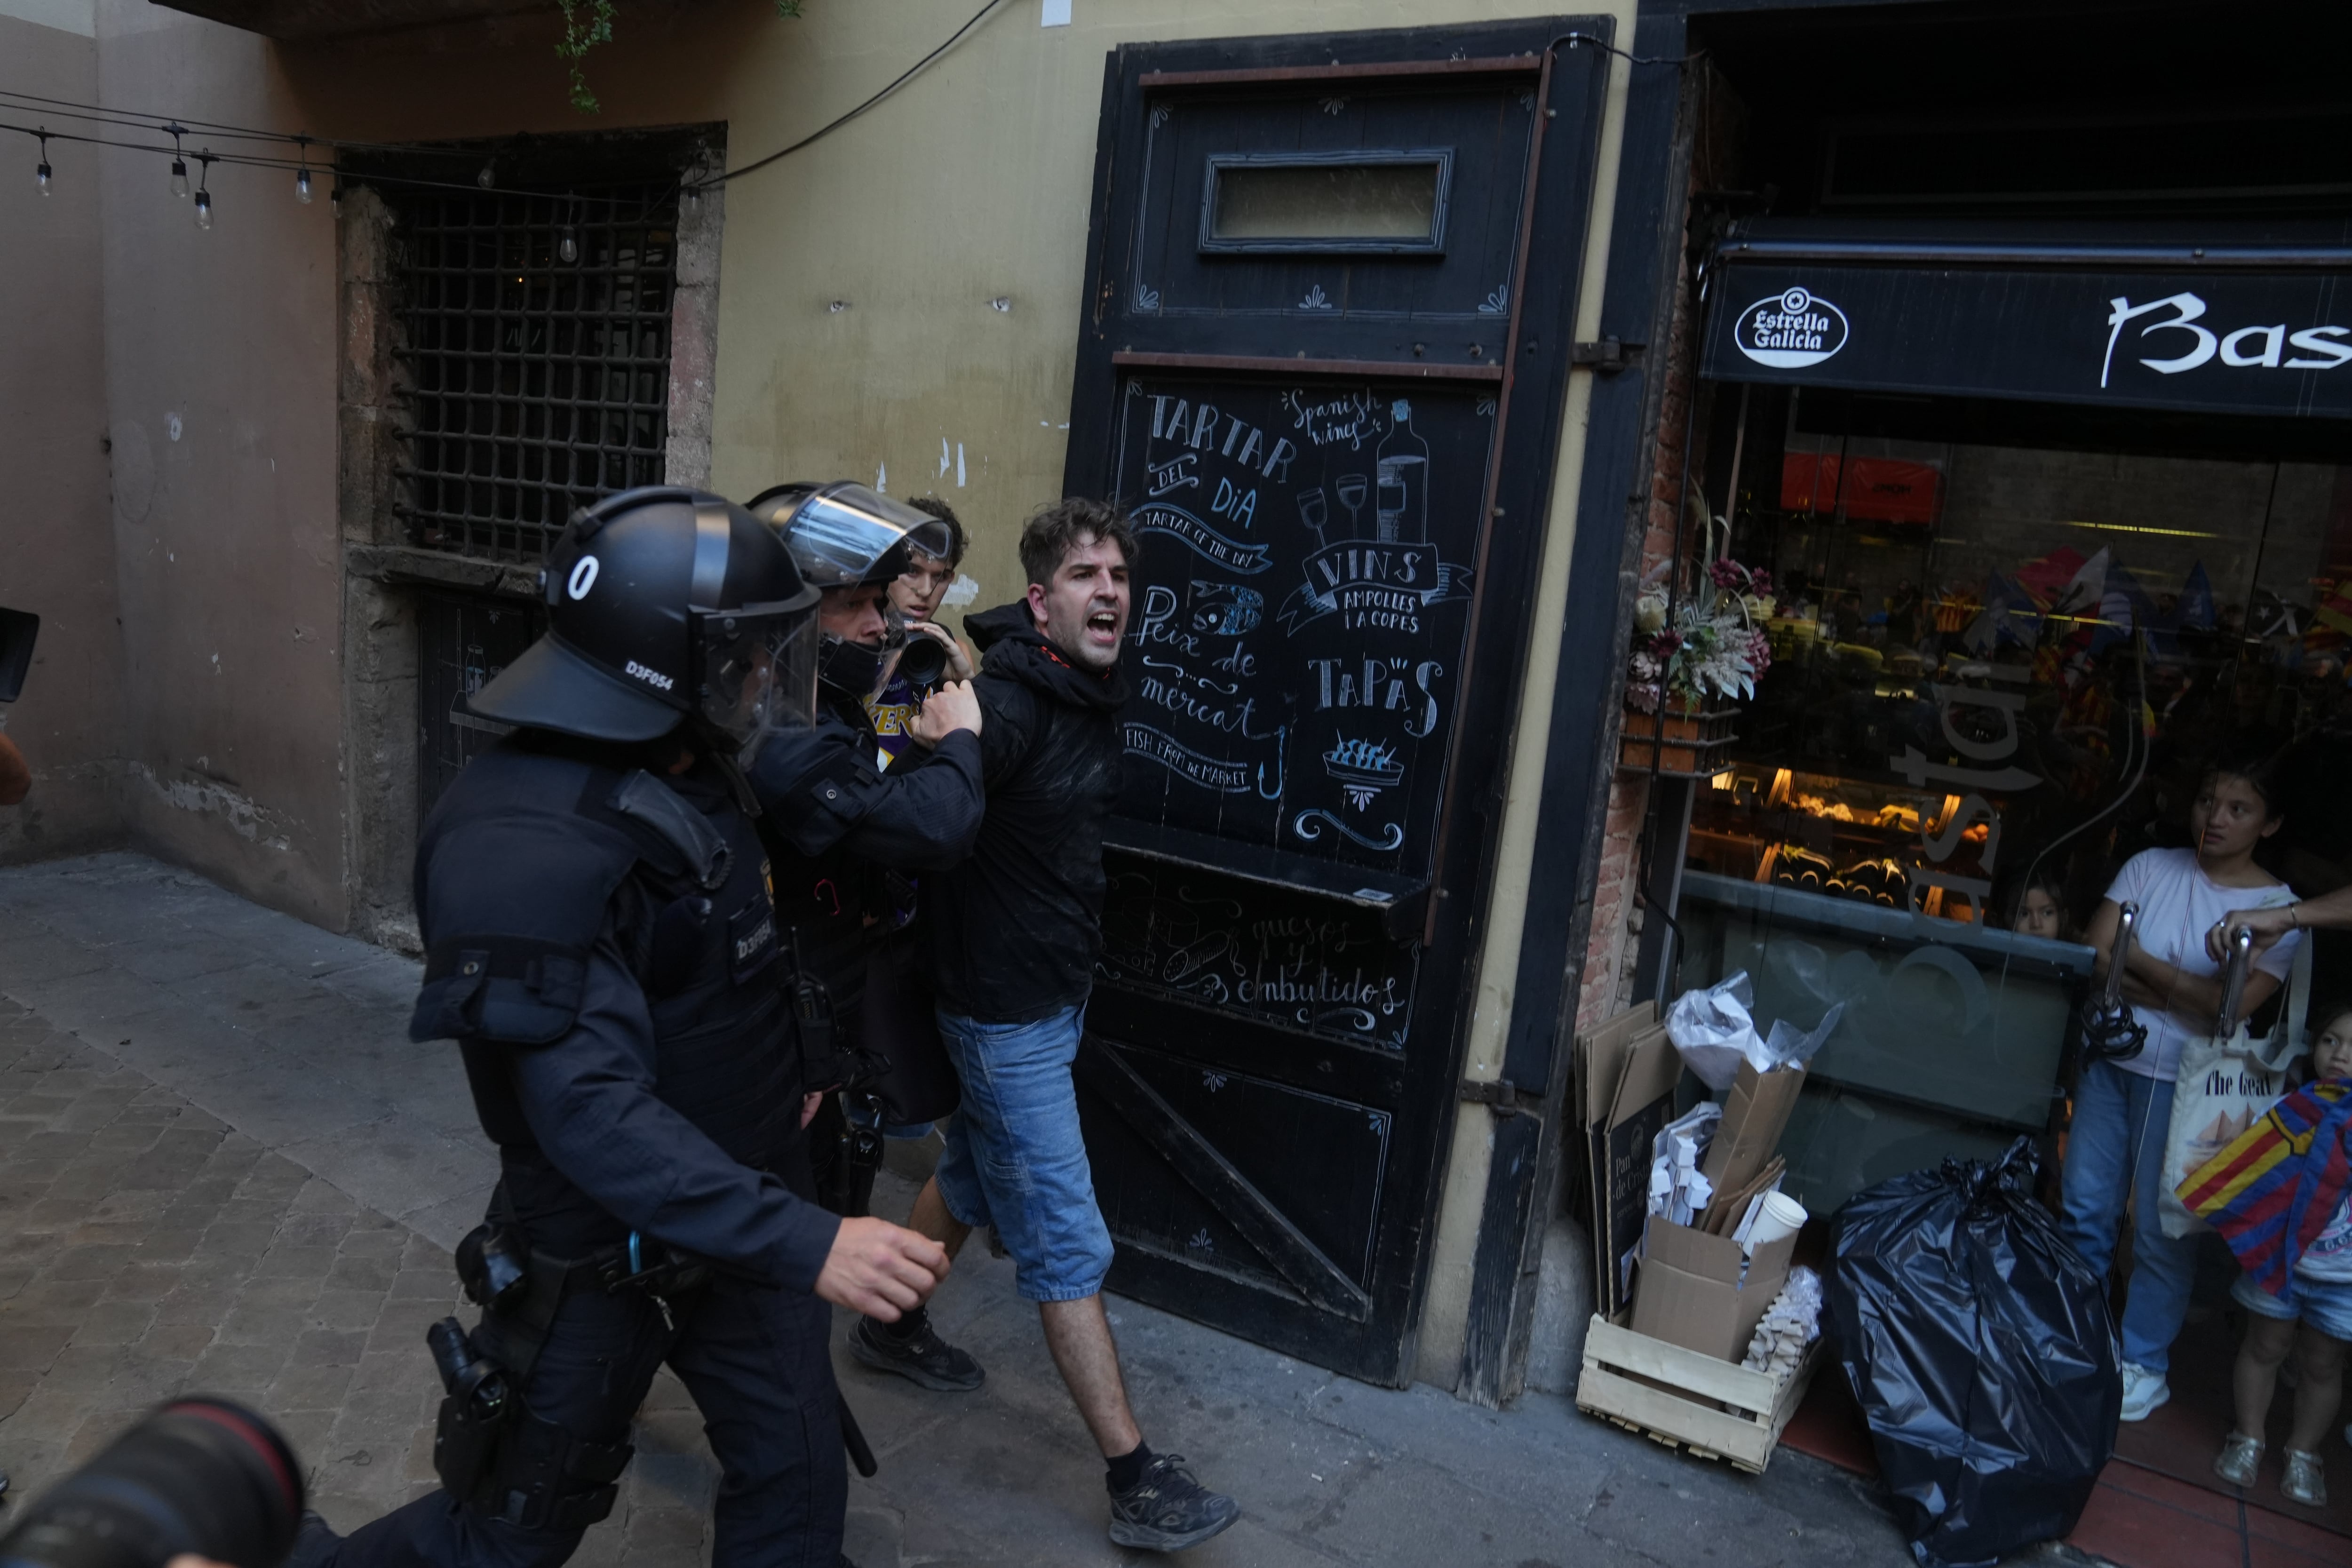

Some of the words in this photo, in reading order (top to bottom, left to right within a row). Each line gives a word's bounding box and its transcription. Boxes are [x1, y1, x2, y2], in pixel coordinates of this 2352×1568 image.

[1752, 310, 1829, 332] Estrella
[1754, 329, 1821, 350] Galicia
[1290, 386, 1383, 437] Spanish
[1147, 395, 1296, 484] TARTAR
[1311, 422, 1374, 452] wines
[1158, 463, 1186, 489] DEL
[1145, 511, 1192, 537] TARTAR
[1193, 528, 1209, 545] OF
[1209, 540, 1230, 560] THE
[1232, 551, 1254, 568] DAY
[1317, 549, 1422, 587] VINS
[1343, 590, 1416, 614] AMPOLLES
[1134, 585, 1200, 658] Peix
[1356, 611, 1366, 629] A
[1371, 610, 1419, 635] COPES
[625, 660, 674, 691] D3F054
[1212, 641, 1257, 677] de
[1141, 675, 1271, 740] mercat
[1126, 729, 1152, 752] FISH
[1157, 740, 1185, 768] FROM
[1187, 761, 1200, 777] THE
[1201, 764, 1246, 786] MARKET
[1252, 917, 1364, 960] quesos
[1287, 942, 1313, 979] y
[1238, 964, 1405, 1016] embutidos
[2206, 1070, 2233, 1096] The
[2239, 1071, 2273, 1097] Great
[1616, 1155, 1630, 1178] Pan
[1616, 1178, 1626, 1201] de
